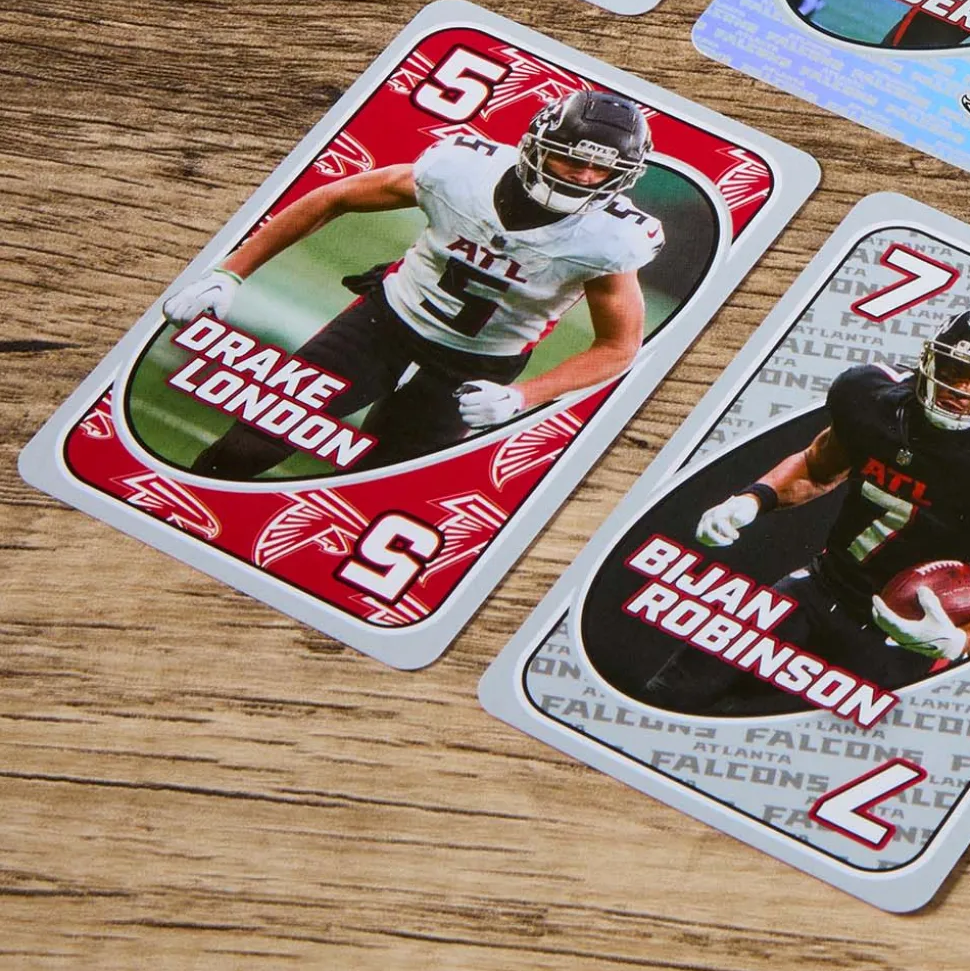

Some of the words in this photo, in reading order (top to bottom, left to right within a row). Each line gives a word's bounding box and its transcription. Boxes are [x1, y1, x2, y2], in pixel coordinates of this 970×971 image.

[414, 46, 511, 122] 5
[453, 136, 498, 156] 5
[446, 235, 527, 284] ATL
[853, 245, 957, 320] 7
[863, 237, 952, 256] ATNTA
[419, 256, 510, 338] 5
[174, 316, 347, 409] DRAKE
[793, 325, 885, 346] ATLANTA
[168, 358, 373, 467] LONDON
[861, 457, 931, 506] ATL
[337, 511, 444, 603] 5
[848, 481, 915, 563] 7
[628, 537, 793, 631] BIJAN
[626, 582, 895, 728] ROBINSON
[651, 749, 830, 793] FALCONS
[693, 741, 792, 765] ATLANTA
[745, 727, 924, 766] FALCONS
[811, 759, 925, 848] 7
